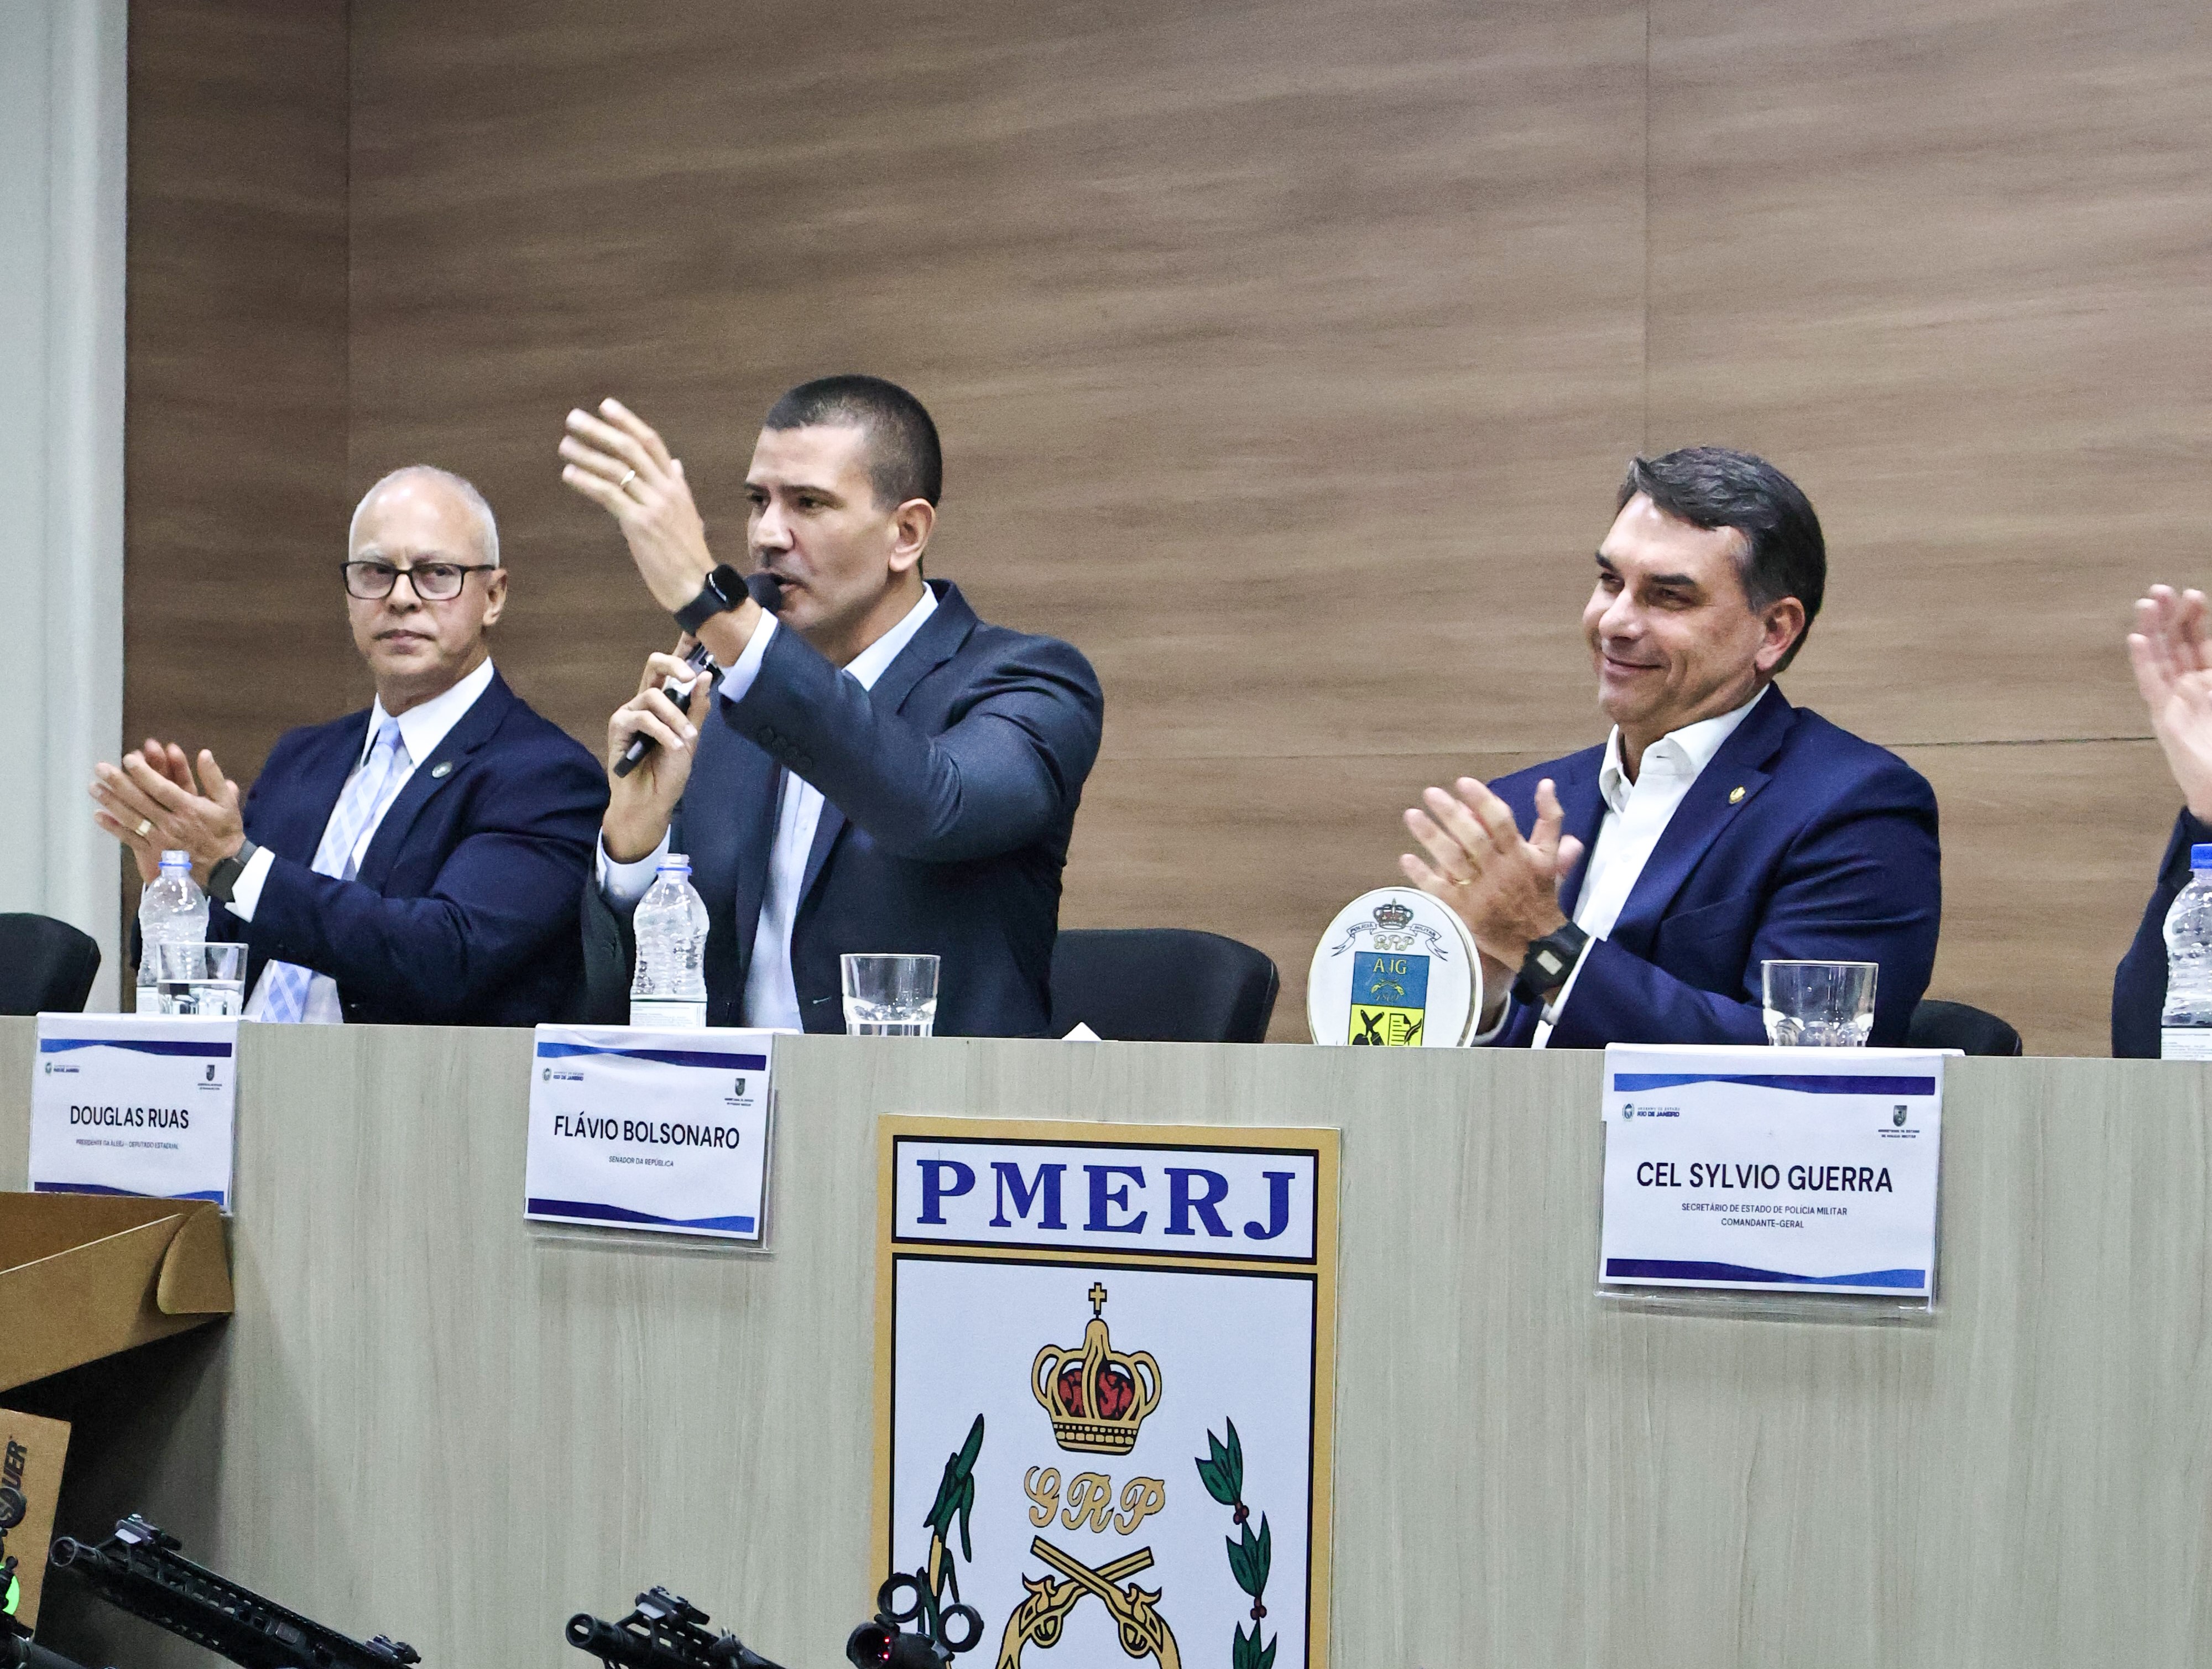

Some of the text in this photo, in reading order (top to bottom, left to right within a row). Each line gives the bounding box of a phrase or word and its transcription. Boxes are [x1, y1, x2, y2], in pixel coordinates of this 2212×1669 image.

[70, 1105, 190, 1129] DOUGLAS RUAS
[554, 1112, 740, 1150] FLÁVIO BOLSONARO
[609, 1156, 635, 1164] SENADOR
[644, 1158, 674, 1167] REPÚBLICA
[1636, 1161, 1893, 1193] CEL SYLVIO GUERRA
[916, 1159, 1296, 1240] PMERJ
[1681, 1202, 1728, 1212] SECRETÁRIO
[1729, 1204, 1740, 1213] DE
[1741, 1204, 1772, 1214] ESTADO
[1773, 1206, 1783, 1214] DE
[1816, 1206, 1848, 1216] MILITAR
[1720, 1217, 1805, 1229] COMANDANTE-GERAL
[1024, 1464, 1166, 1536] GRP
